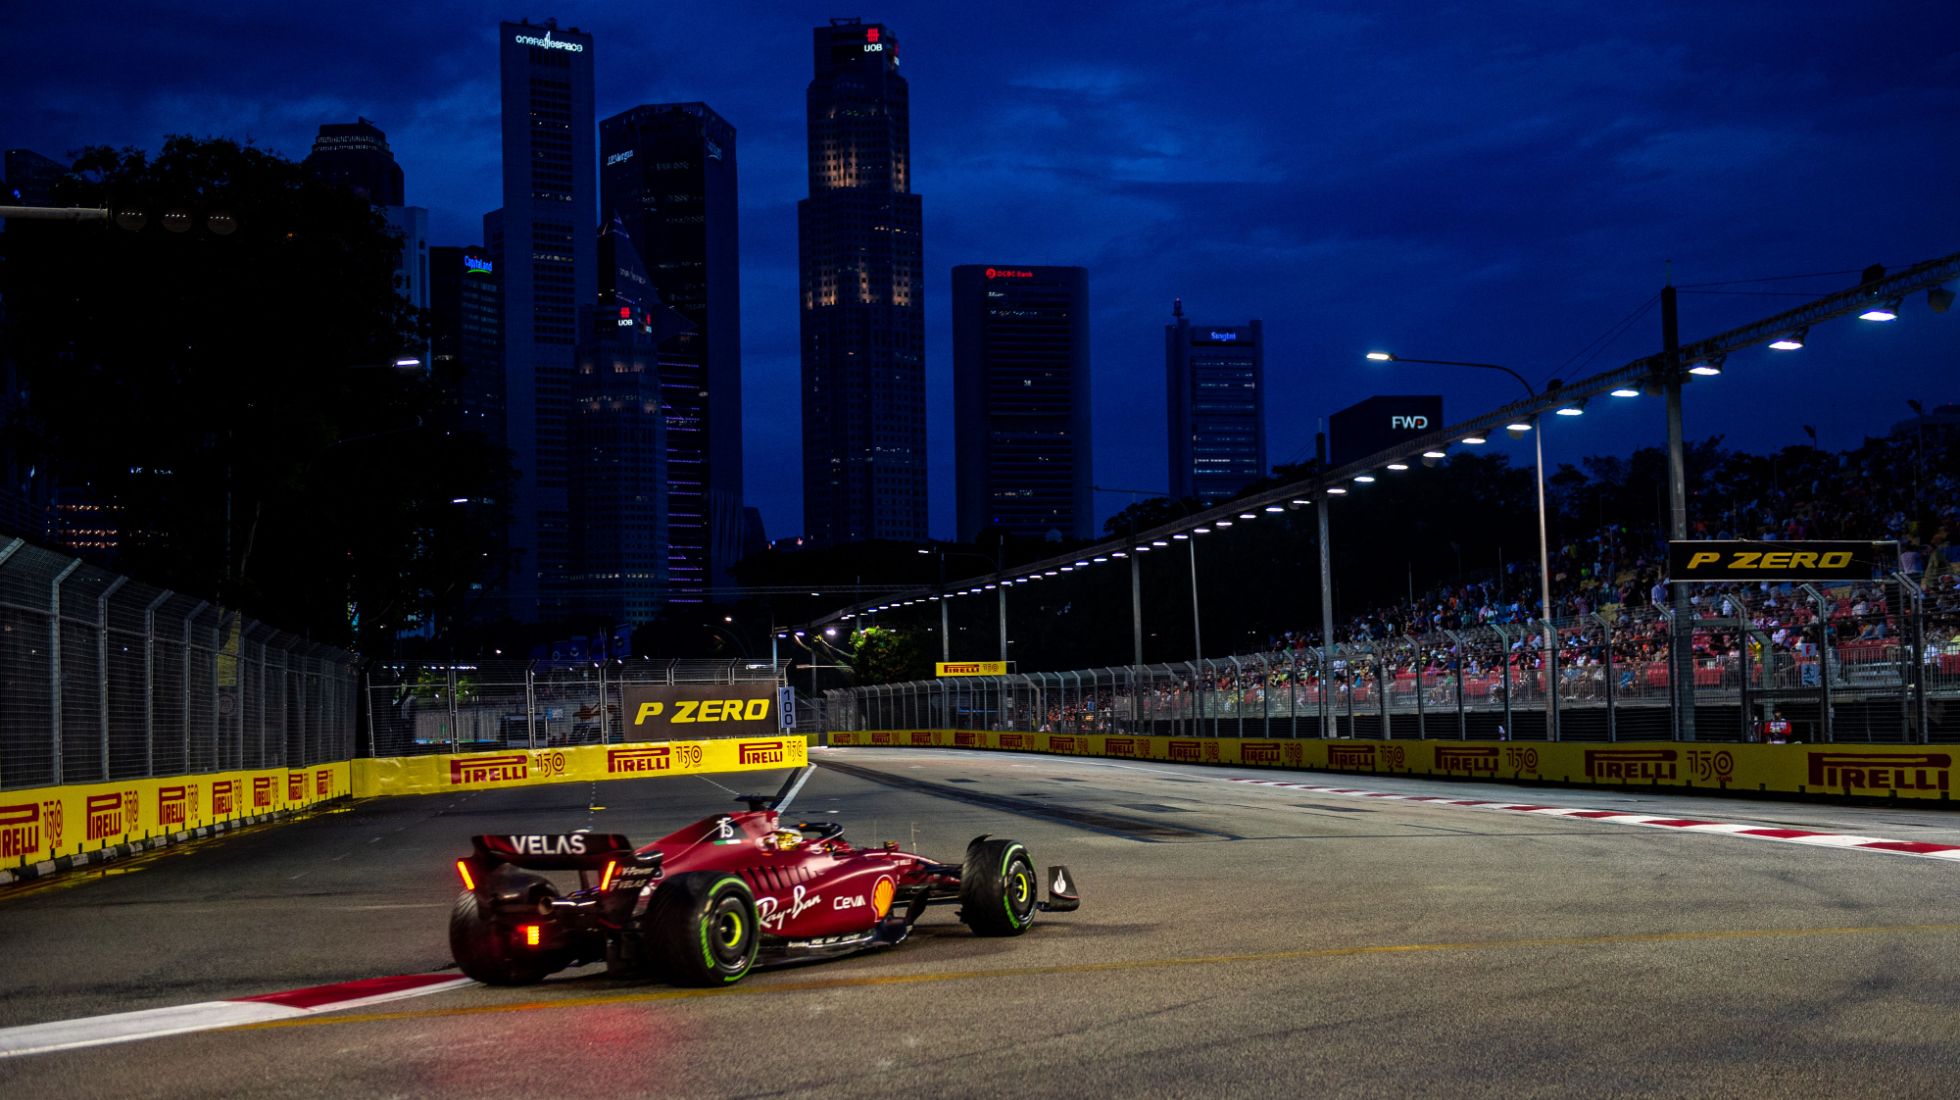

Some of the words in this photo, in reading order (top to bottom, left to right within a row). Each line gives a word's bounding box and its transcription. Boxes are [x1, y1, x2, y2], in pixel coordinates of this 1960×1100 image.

[864, 43, 883, 52] UOB
[1392, 415, 1428, 429] FWD
[1687, 552, 1721, 569] P
[1728, 552, 1853, 569] ZERO
[943, 664, 980, 674] PIRELLI
[634, 702, 665, 726] P
[670, 698, 770, 723] ZERO
[783, 689, 793, 725] 100
[608, 747, 670, 773] PIRELLI
[676, 745, 703, 769] 150
[739, 741, 783, 765] PIRELLI
[1168, 741, 1201, 758] PIRELLI
[1241, 743, 1281, 762] PIRELLI
[1328, 744, 1375, 767] PIRELLI
[1435, 746, 1499, 772] PIRELLI
[1506, 747, 1538, 773] 150
[451, 755, 527, 785] PIRELLI
[535, 752, 565, 778] 150
[1585, 750, 1677, 779] PIRELLI
[1687, 751, 1733, 781] 150
[1808, 752, 1952, 790] PIRELLI
[159, 786, 186, 826] PIRELLI
[213, 781, 232, 816] PIRELLI
[43, 799, 63, 850] 150
[87, 792, 121, 841] PIRELLI
[755, 885, 822, 931] Ray-Ban
